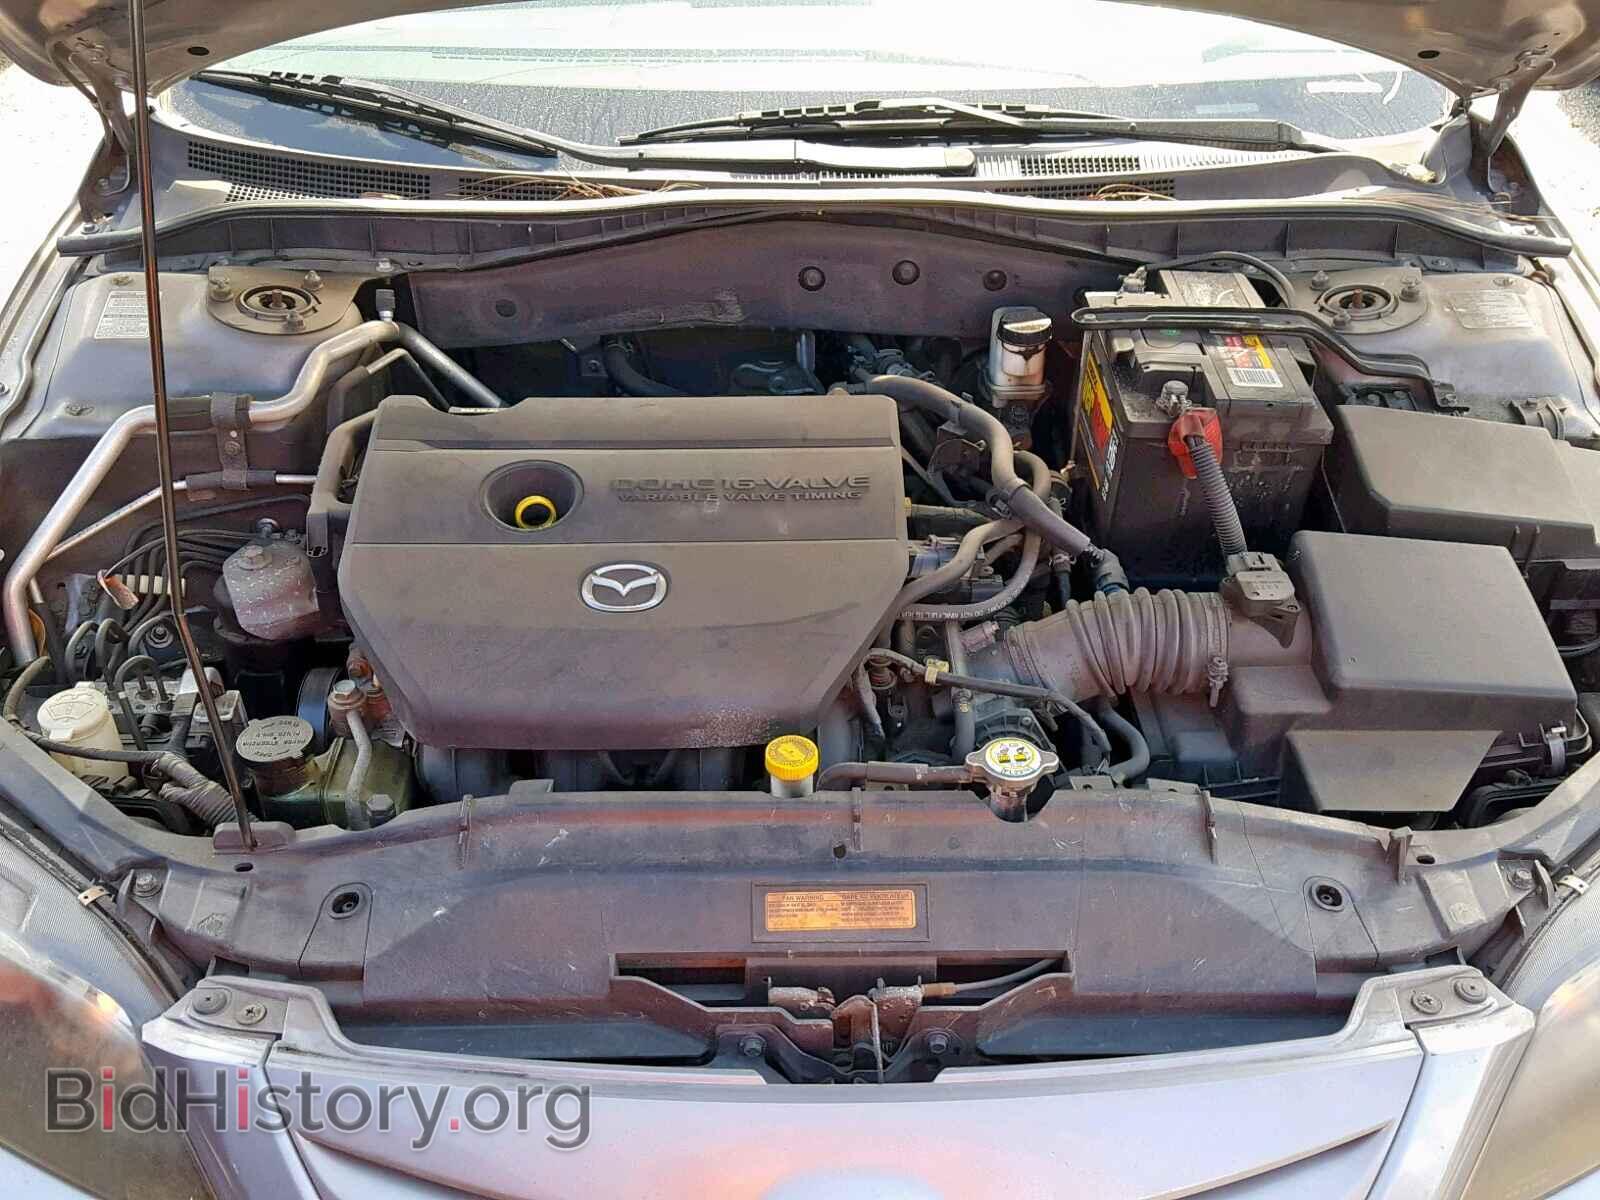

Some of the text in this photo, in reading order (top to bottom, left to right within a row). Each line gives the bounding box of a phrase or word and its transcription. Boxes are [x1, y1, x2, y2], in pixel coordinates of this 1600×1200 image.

[609, 476, 871, 491] DOHC 16-VALVE
[616, 491, 862, 503] VARIABLE VALVE TIMING
